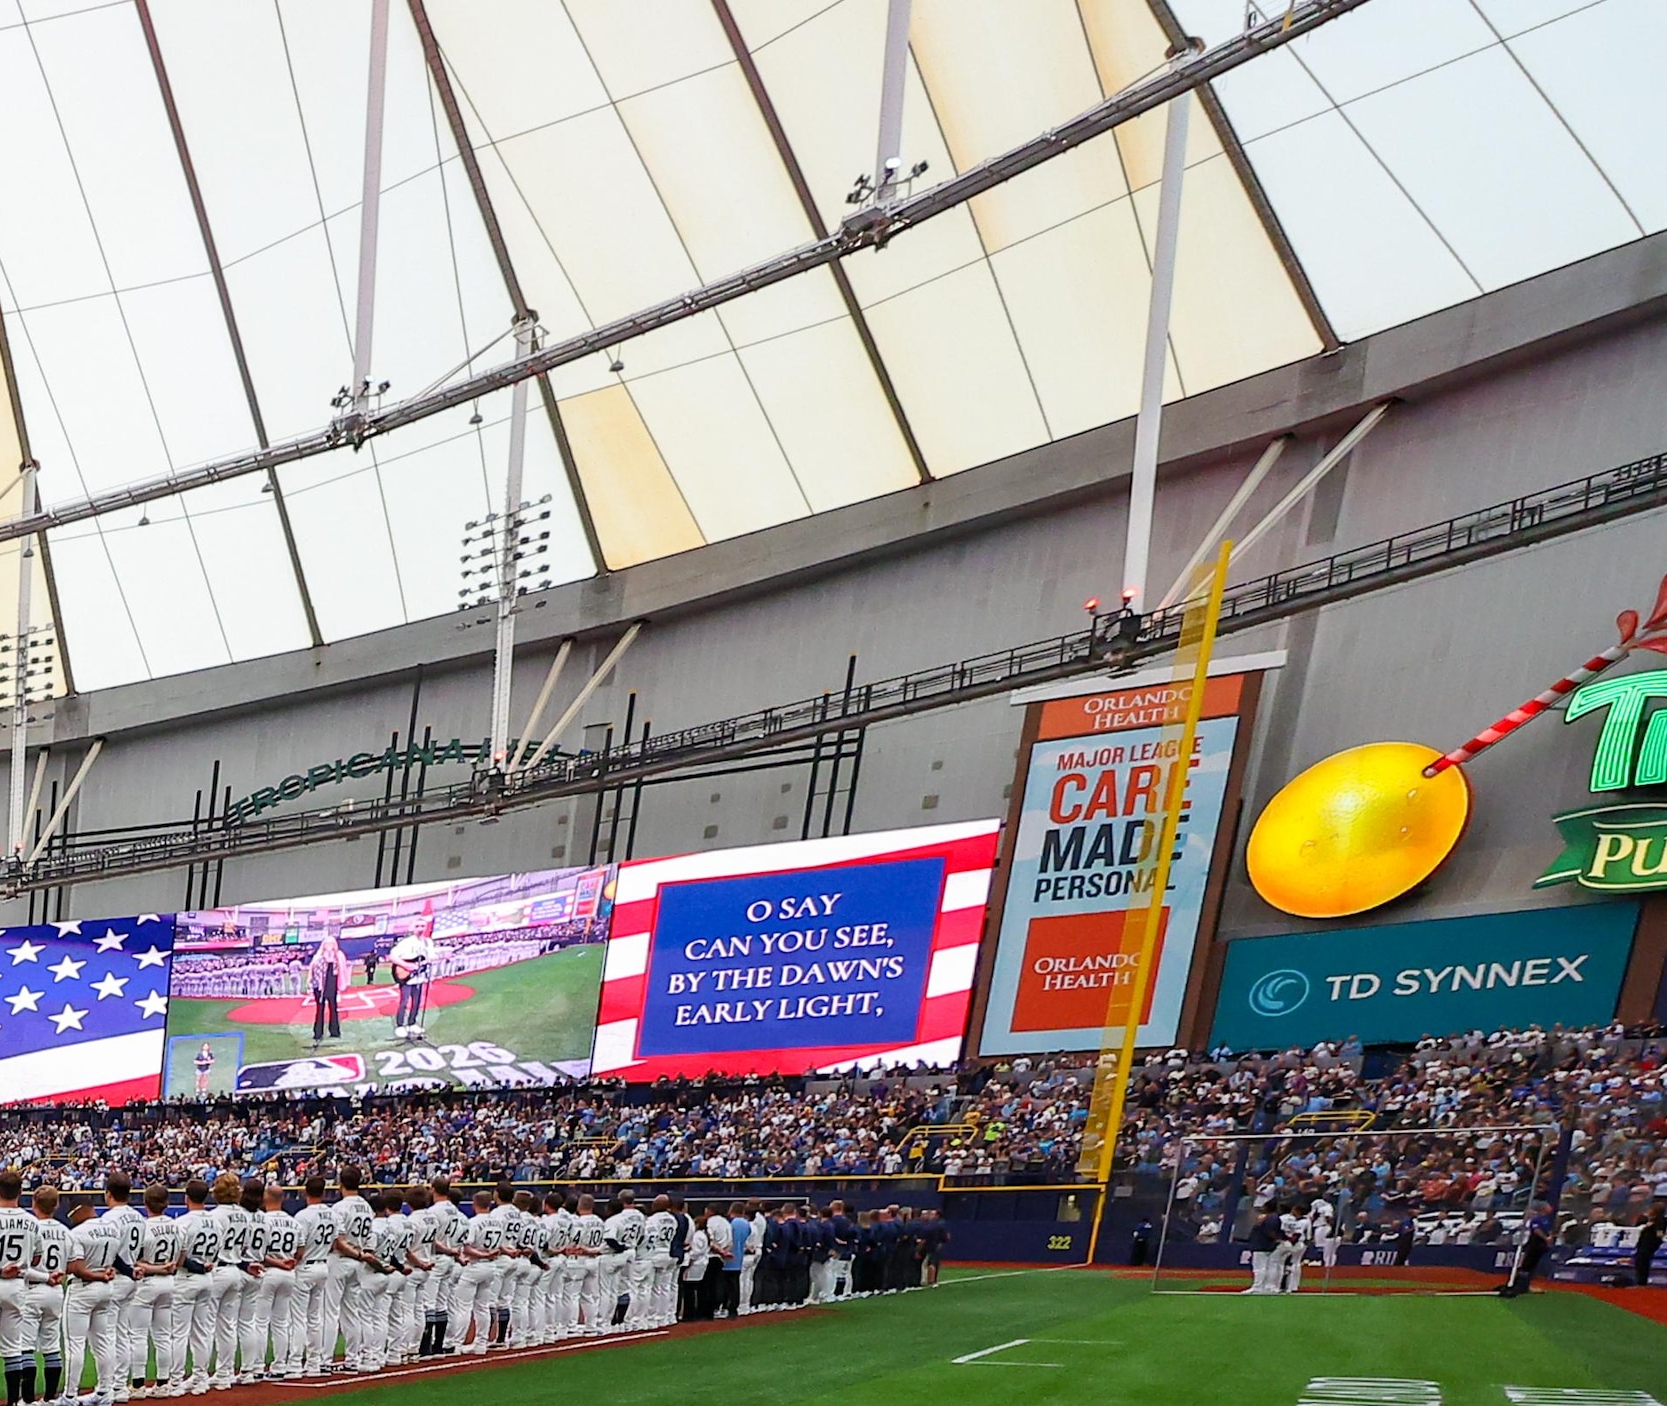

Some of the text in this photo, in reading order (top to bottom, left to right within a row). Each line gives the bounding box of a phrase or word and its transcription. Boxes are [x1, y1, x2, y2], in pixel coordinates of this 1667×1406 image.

[1092, 706, 1180, 731] HEALTH
[1056, 748, 1124, 772] MAJOR
[227, 737, 467, 826] TROPICANA
[1048, 758, 1201, 825] CARE
[1038, 814, 1190, 875] MADE
[746, 892, 842, 923] O SAY
[684, 922, 895, 961] CAN YOU SEE,
[667, 956, 905, 995] BY THE DAWN'S
[1325, 954, 1590, 1002] TD SYNNEX
[674, 991, 885, 1026] EARLY LIGHT,
[373, 1040, 518, 1078] 2026
[129, 1226, 140, 1251] 9
[223, 1227, 247, 1250] 24
[314, 1223, 335, 1245] 32
[351, 1216, 372, 1238] 36
[154, 1239, 176, 1263] 21
[192, 1231, 218, 1256] 22
[267, 1231, 295, 1253] 28
[483, 1231, 502, 1249] 57
[1047, 1235, 1072, 1250] 322
[46, 1244, 60, 1270] 6
[100, 1241, 109, 1266] 1
